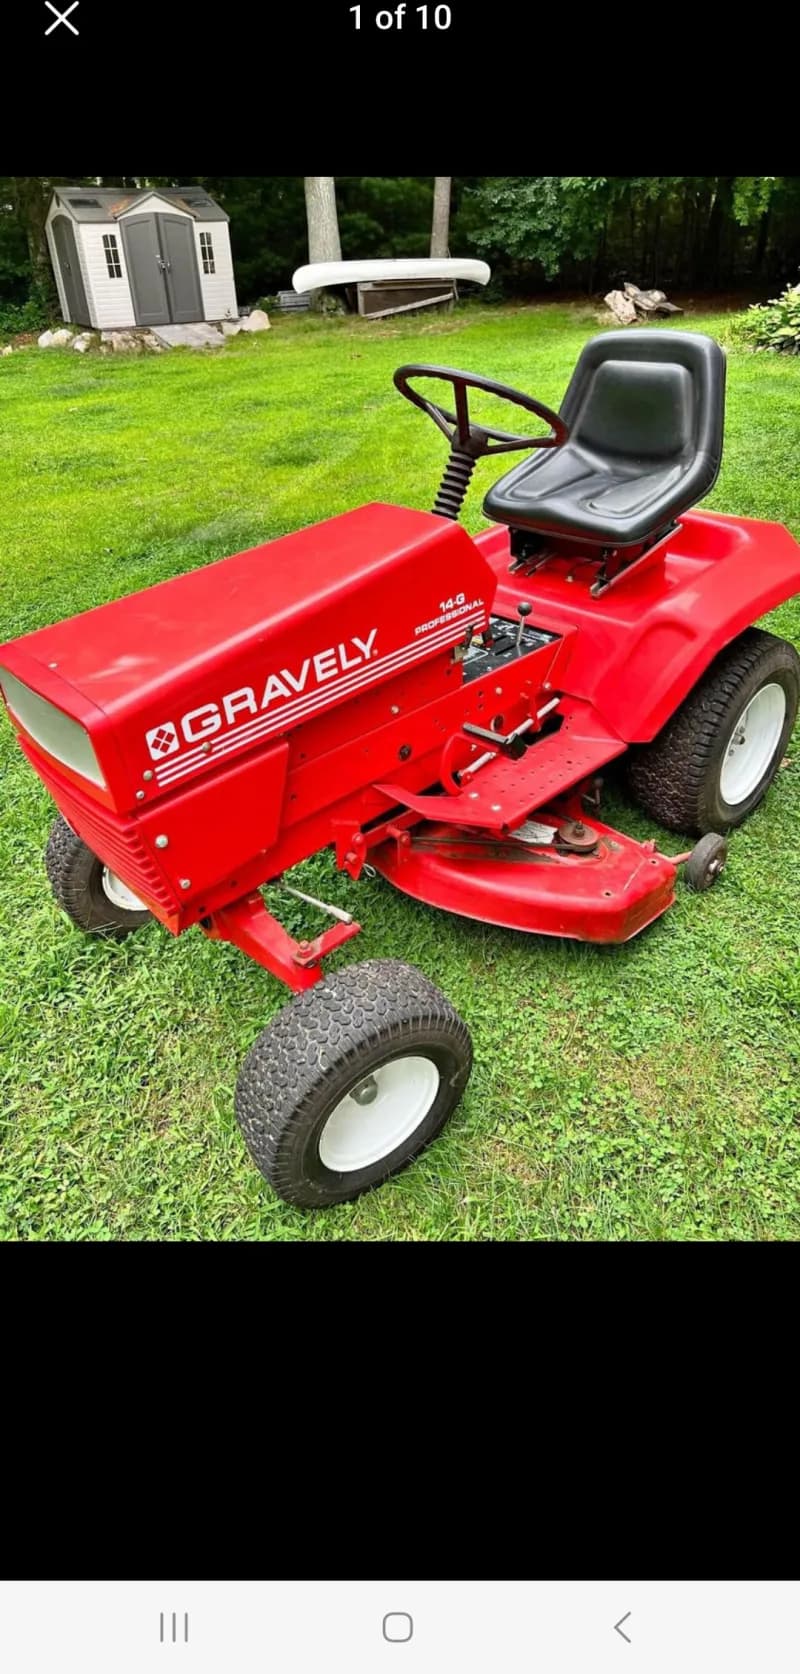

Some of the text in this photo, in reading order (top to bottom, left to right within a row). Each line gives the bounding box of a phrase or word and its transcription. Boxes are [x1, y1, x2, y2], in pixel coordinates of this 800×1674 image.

[415, 599, 484, 636] PROFESSIONAL
[439, 592, 466, 613] 14-G
[181, 629, 378, 743] GRAVELY
